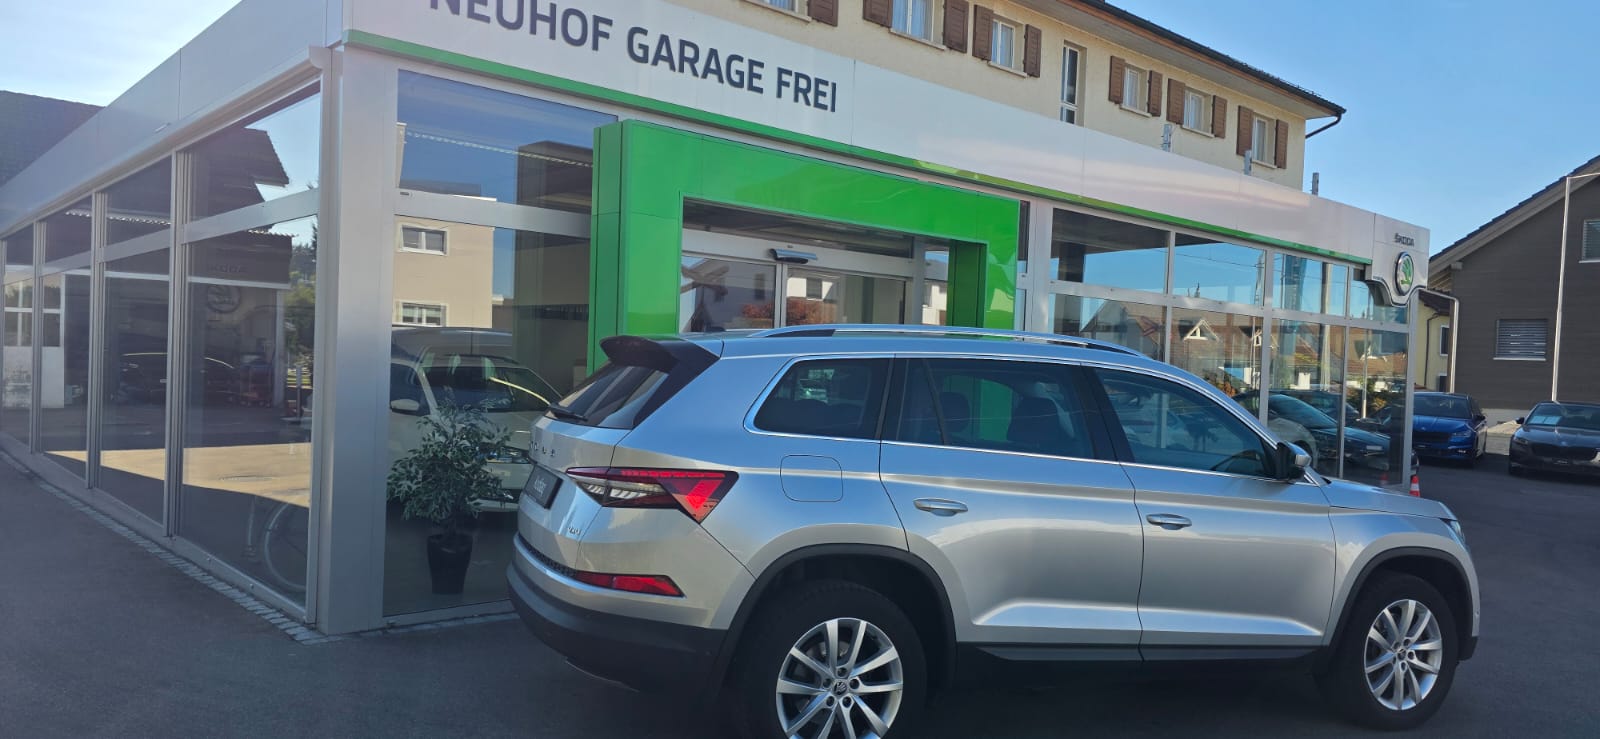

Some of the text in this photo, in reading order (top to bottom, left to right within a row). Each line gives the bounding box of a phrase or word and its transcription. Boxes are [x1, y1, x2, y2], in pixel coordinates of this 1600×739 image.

[430, 0, 837, 113] EUHOF GARAGE FREI
